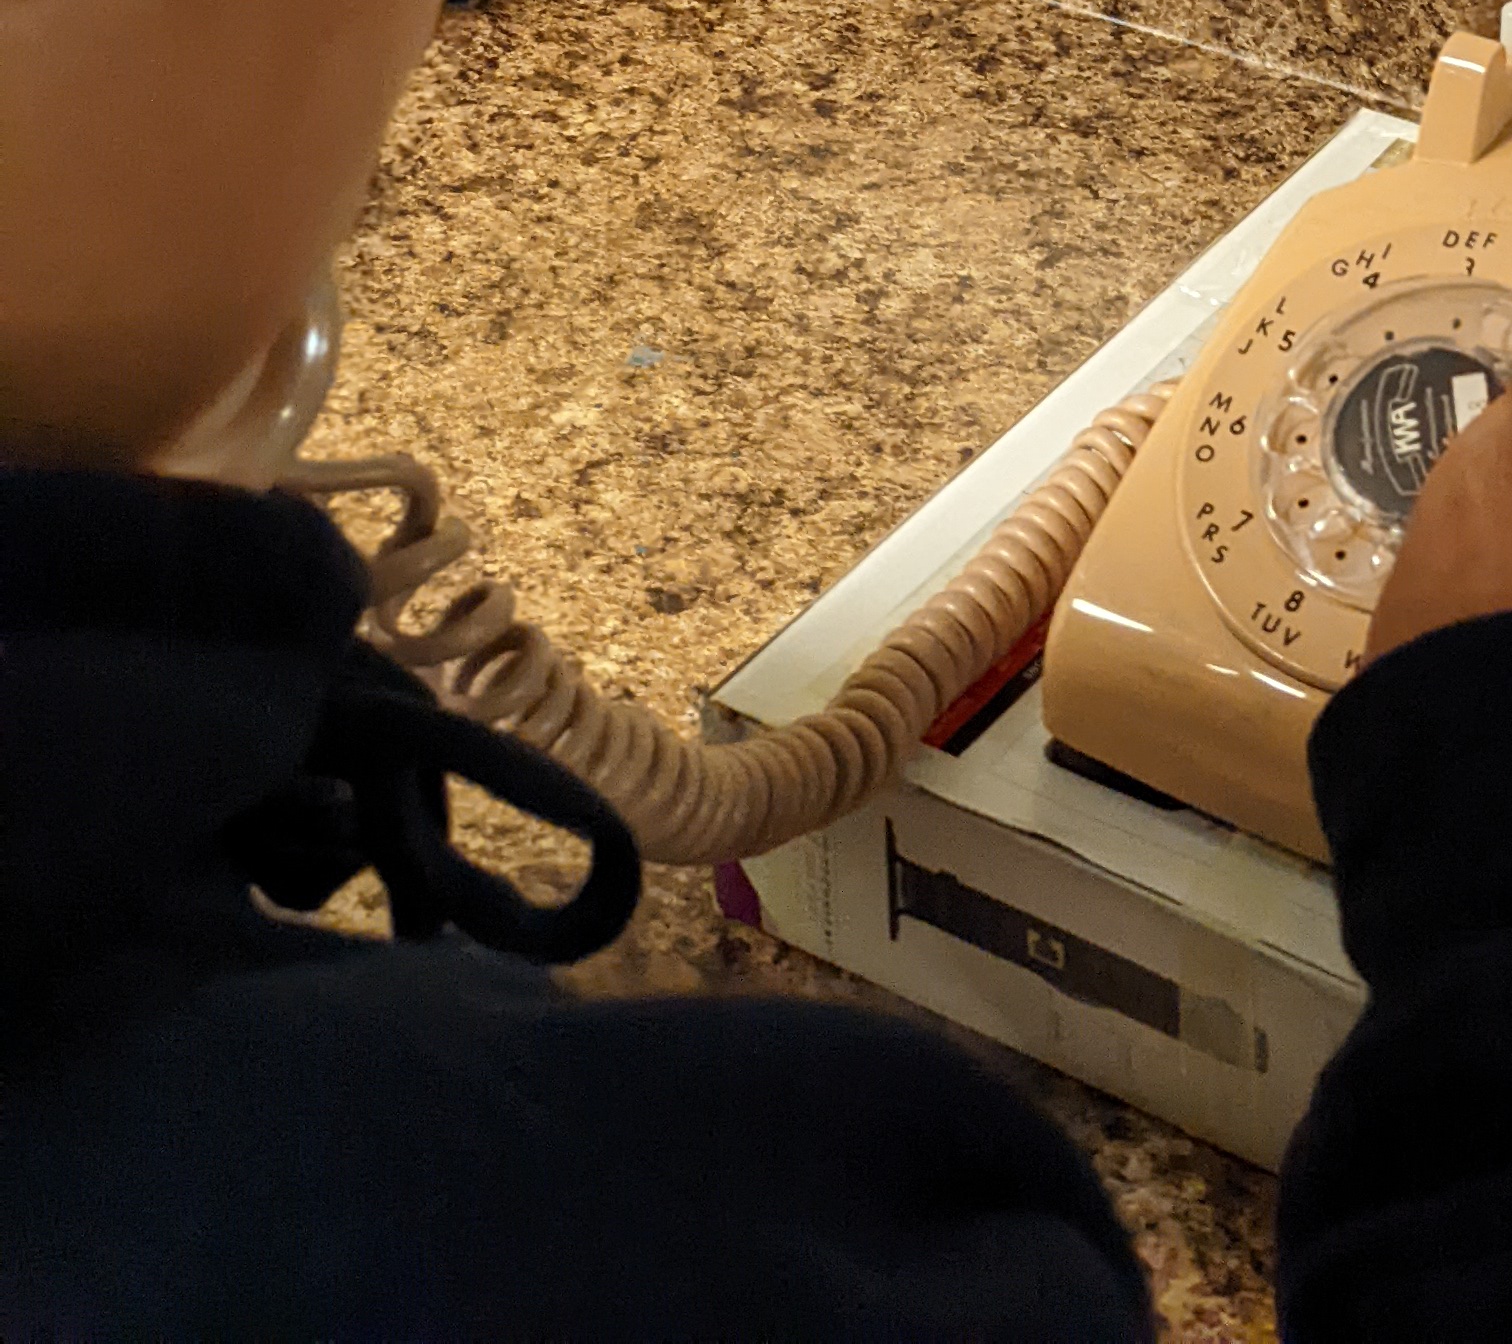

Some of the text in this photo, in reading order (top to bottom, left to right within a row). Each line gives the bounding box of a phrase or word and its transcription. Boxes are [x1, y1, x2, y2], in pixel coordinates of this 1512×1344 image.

[1442, 229, 1498, 250] DEF
[1331, 241, 1392, 277] GHI
[1361, 271, 1381, 290] 4
[1277, 328, 1297, 353] 5
[1194, 391, 1234, 463] MNO
[1229, 414, 1247, 436] 6
[1196, 501, 1229, 564] PRS
[1230, 509, 1255, 532] 7
[1284, 589, 1305, 613] 8
[1251, 601, 1302, 647] TUV
